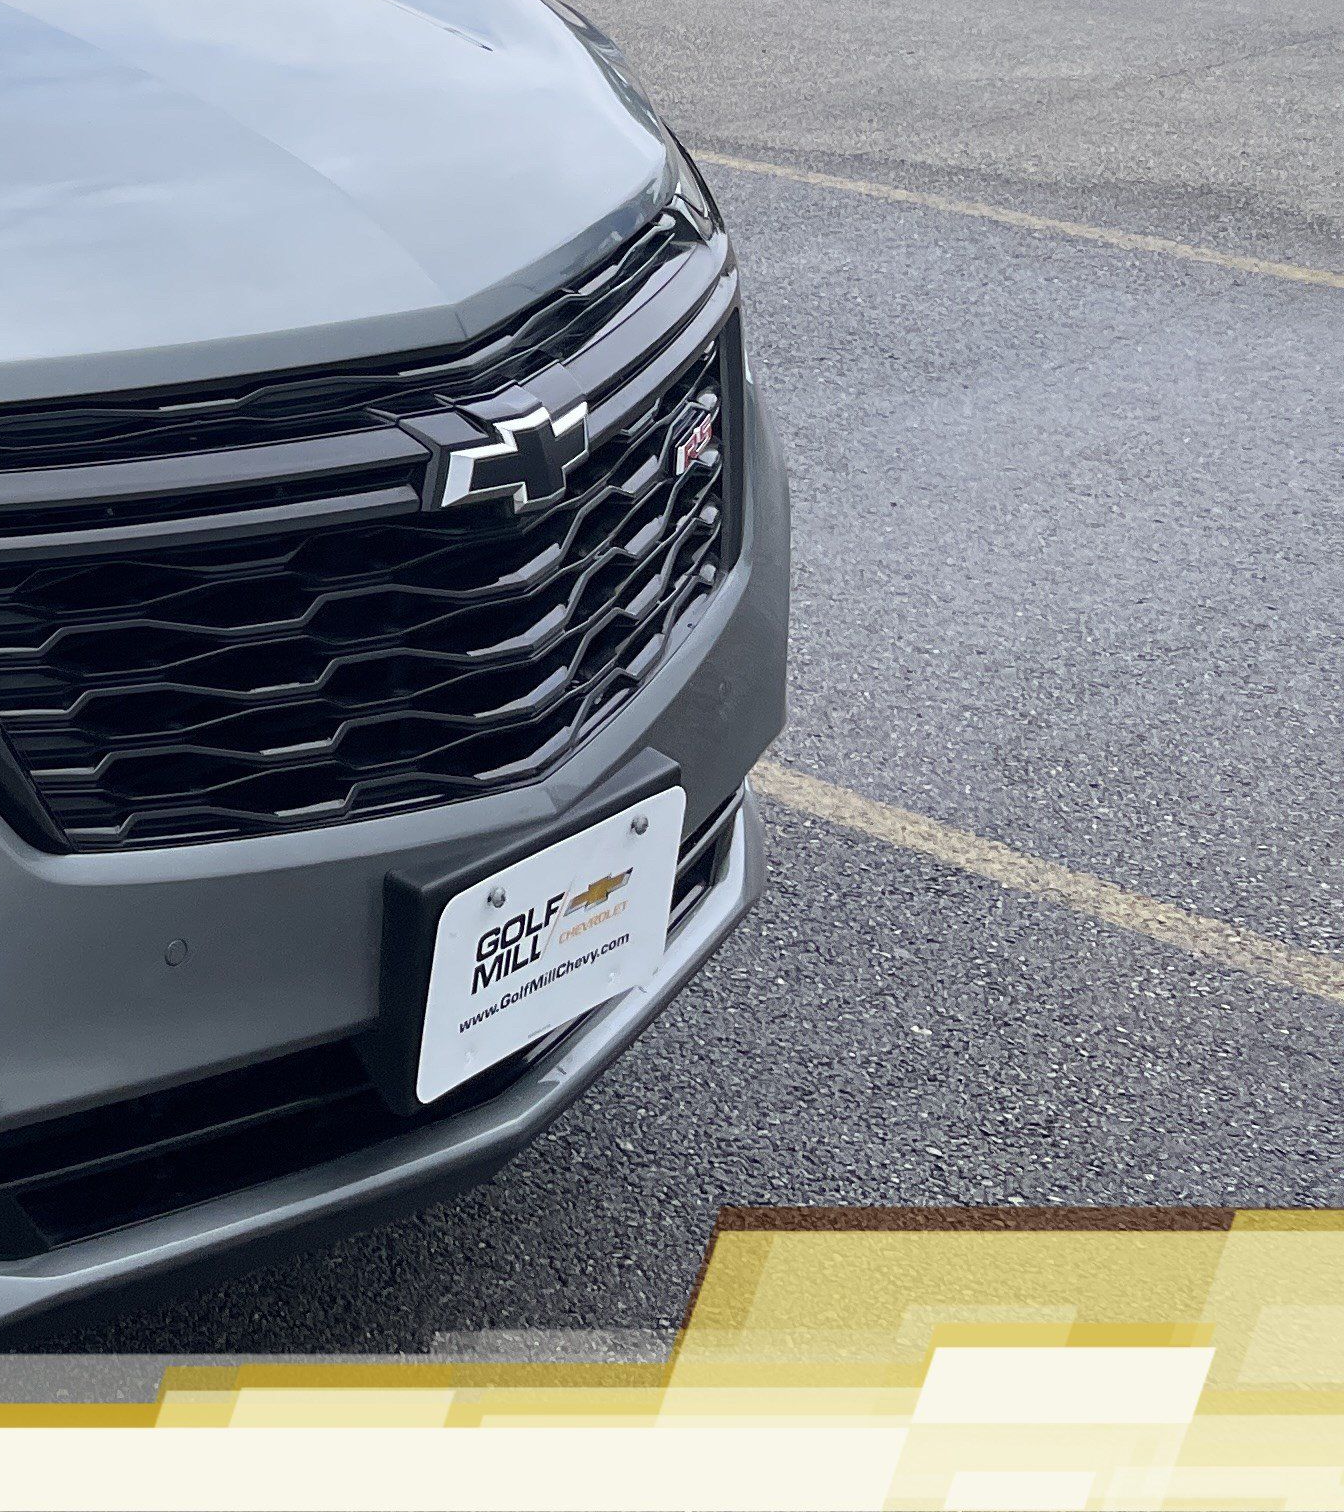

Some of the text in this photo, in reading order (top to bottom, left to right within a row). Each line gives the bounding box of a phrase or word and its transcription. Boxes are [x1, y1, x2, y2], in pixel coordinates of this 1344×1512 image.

[475, 892, 566, 962] GOLF
[558, 899, 630, 945] CHEVROLET
[459, 933, 630, 1034] www.GolfMillChevy.com
[471, 933, 542, 995] MILL
